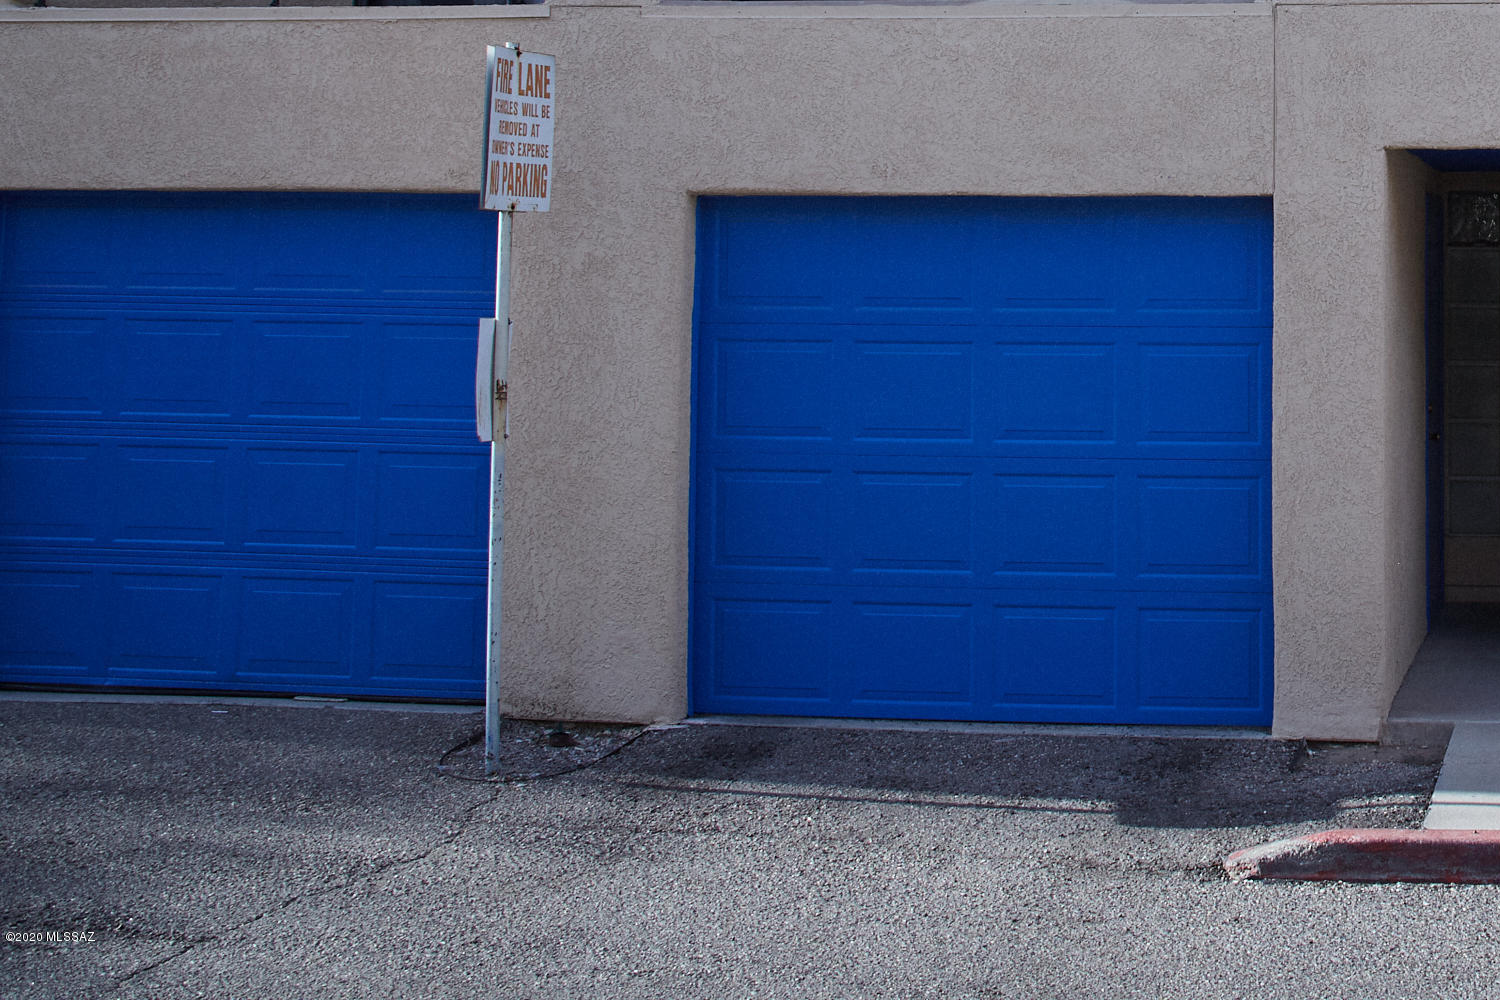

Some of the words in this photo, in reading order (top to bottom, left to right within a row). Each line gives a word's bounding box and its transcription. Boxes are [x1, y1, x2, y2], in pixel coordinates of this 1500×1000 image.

[495, 57, 514, 95] FIRE
[518, 61, 550, 99] LANE
[494, 98, 518, 116] VEHICLES
[521, 102, 539, 118] WILL
[541, 104, 550, 119] BE
[499, 119, 527, 137] REMOVED
[531, 123, 540, 138] AT
[517, 142, 549, 159] EXPENSE
[489, 160, 500, 195] NO
[502, 162, 548, 198] PARKING
